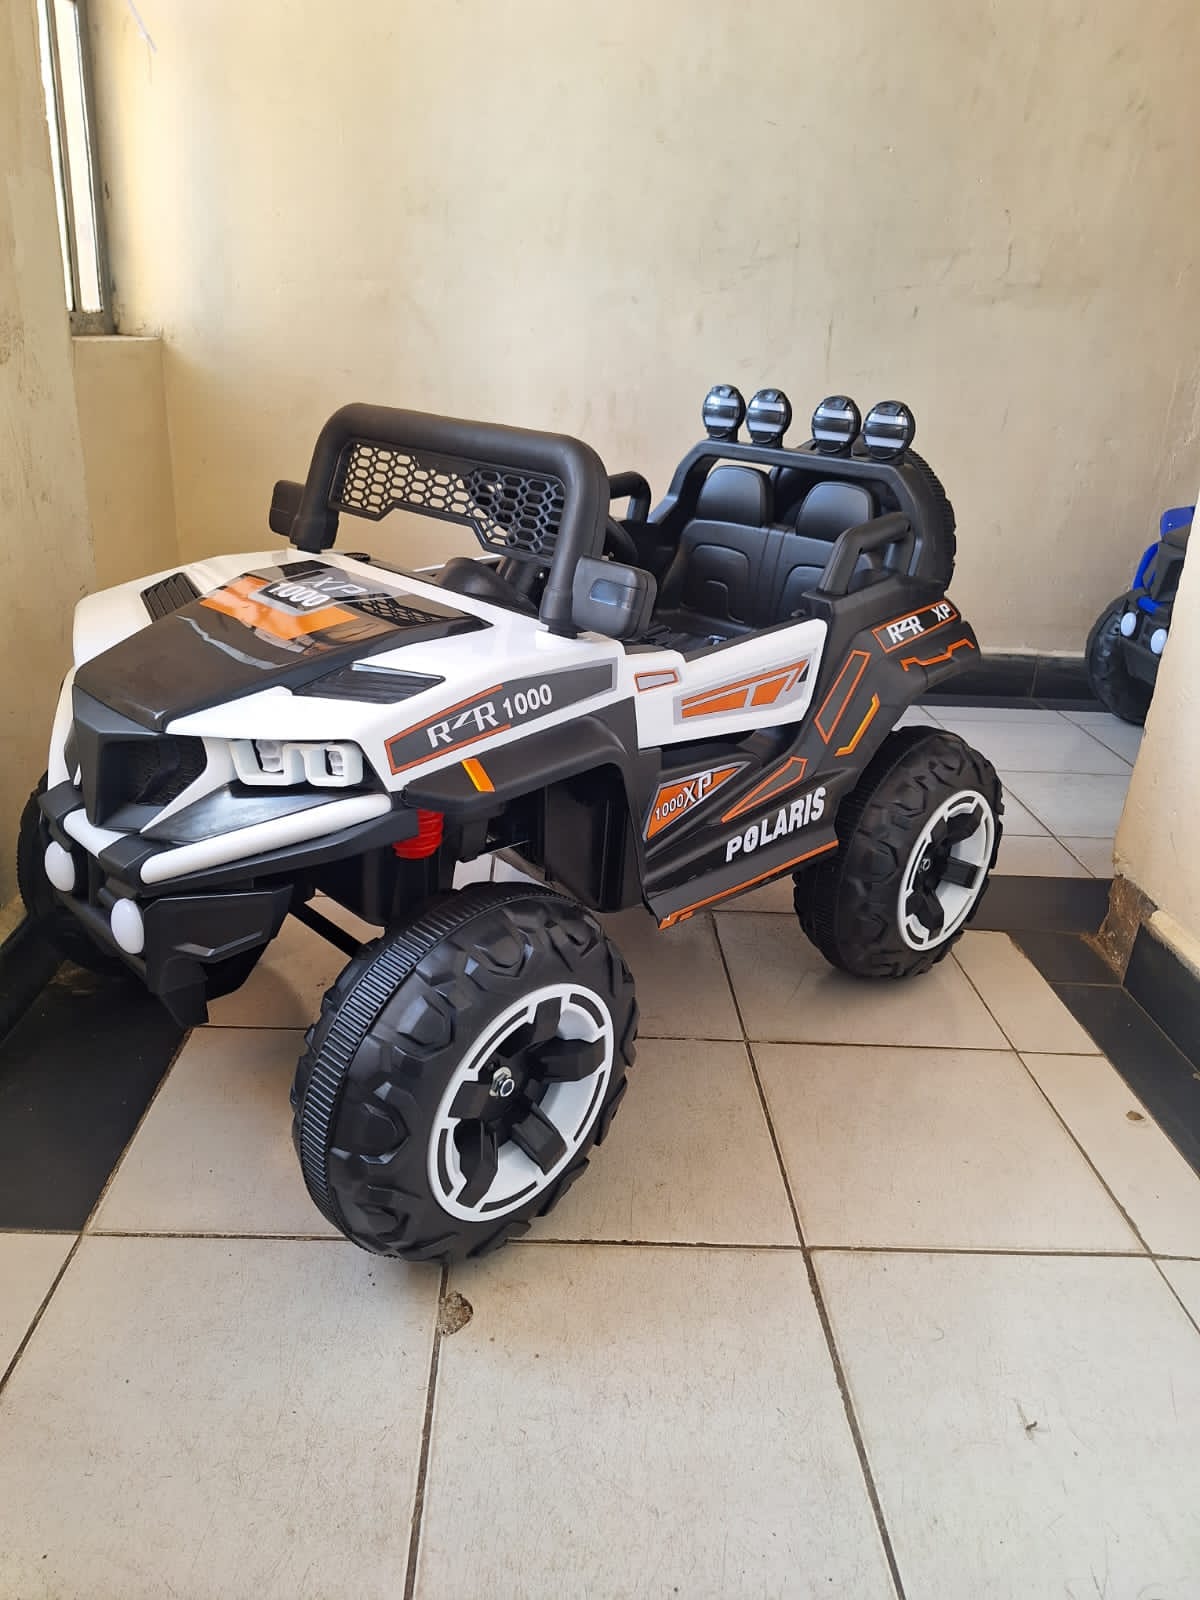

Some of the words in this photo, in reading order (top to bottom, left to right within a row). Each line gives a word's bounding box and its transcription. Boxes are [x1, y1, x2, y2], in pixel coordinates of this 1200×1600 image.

[268, 582, 331, 607] 1000
[312, 577, 369, 595] XP
[886, 615, 925, 644] RZR
[930, 603, 951, 622] XP
[426, 701, 500, 748] RZR
[502, 684, 553, 719] 1000
[725, 786, 827, 863] POLARIS
